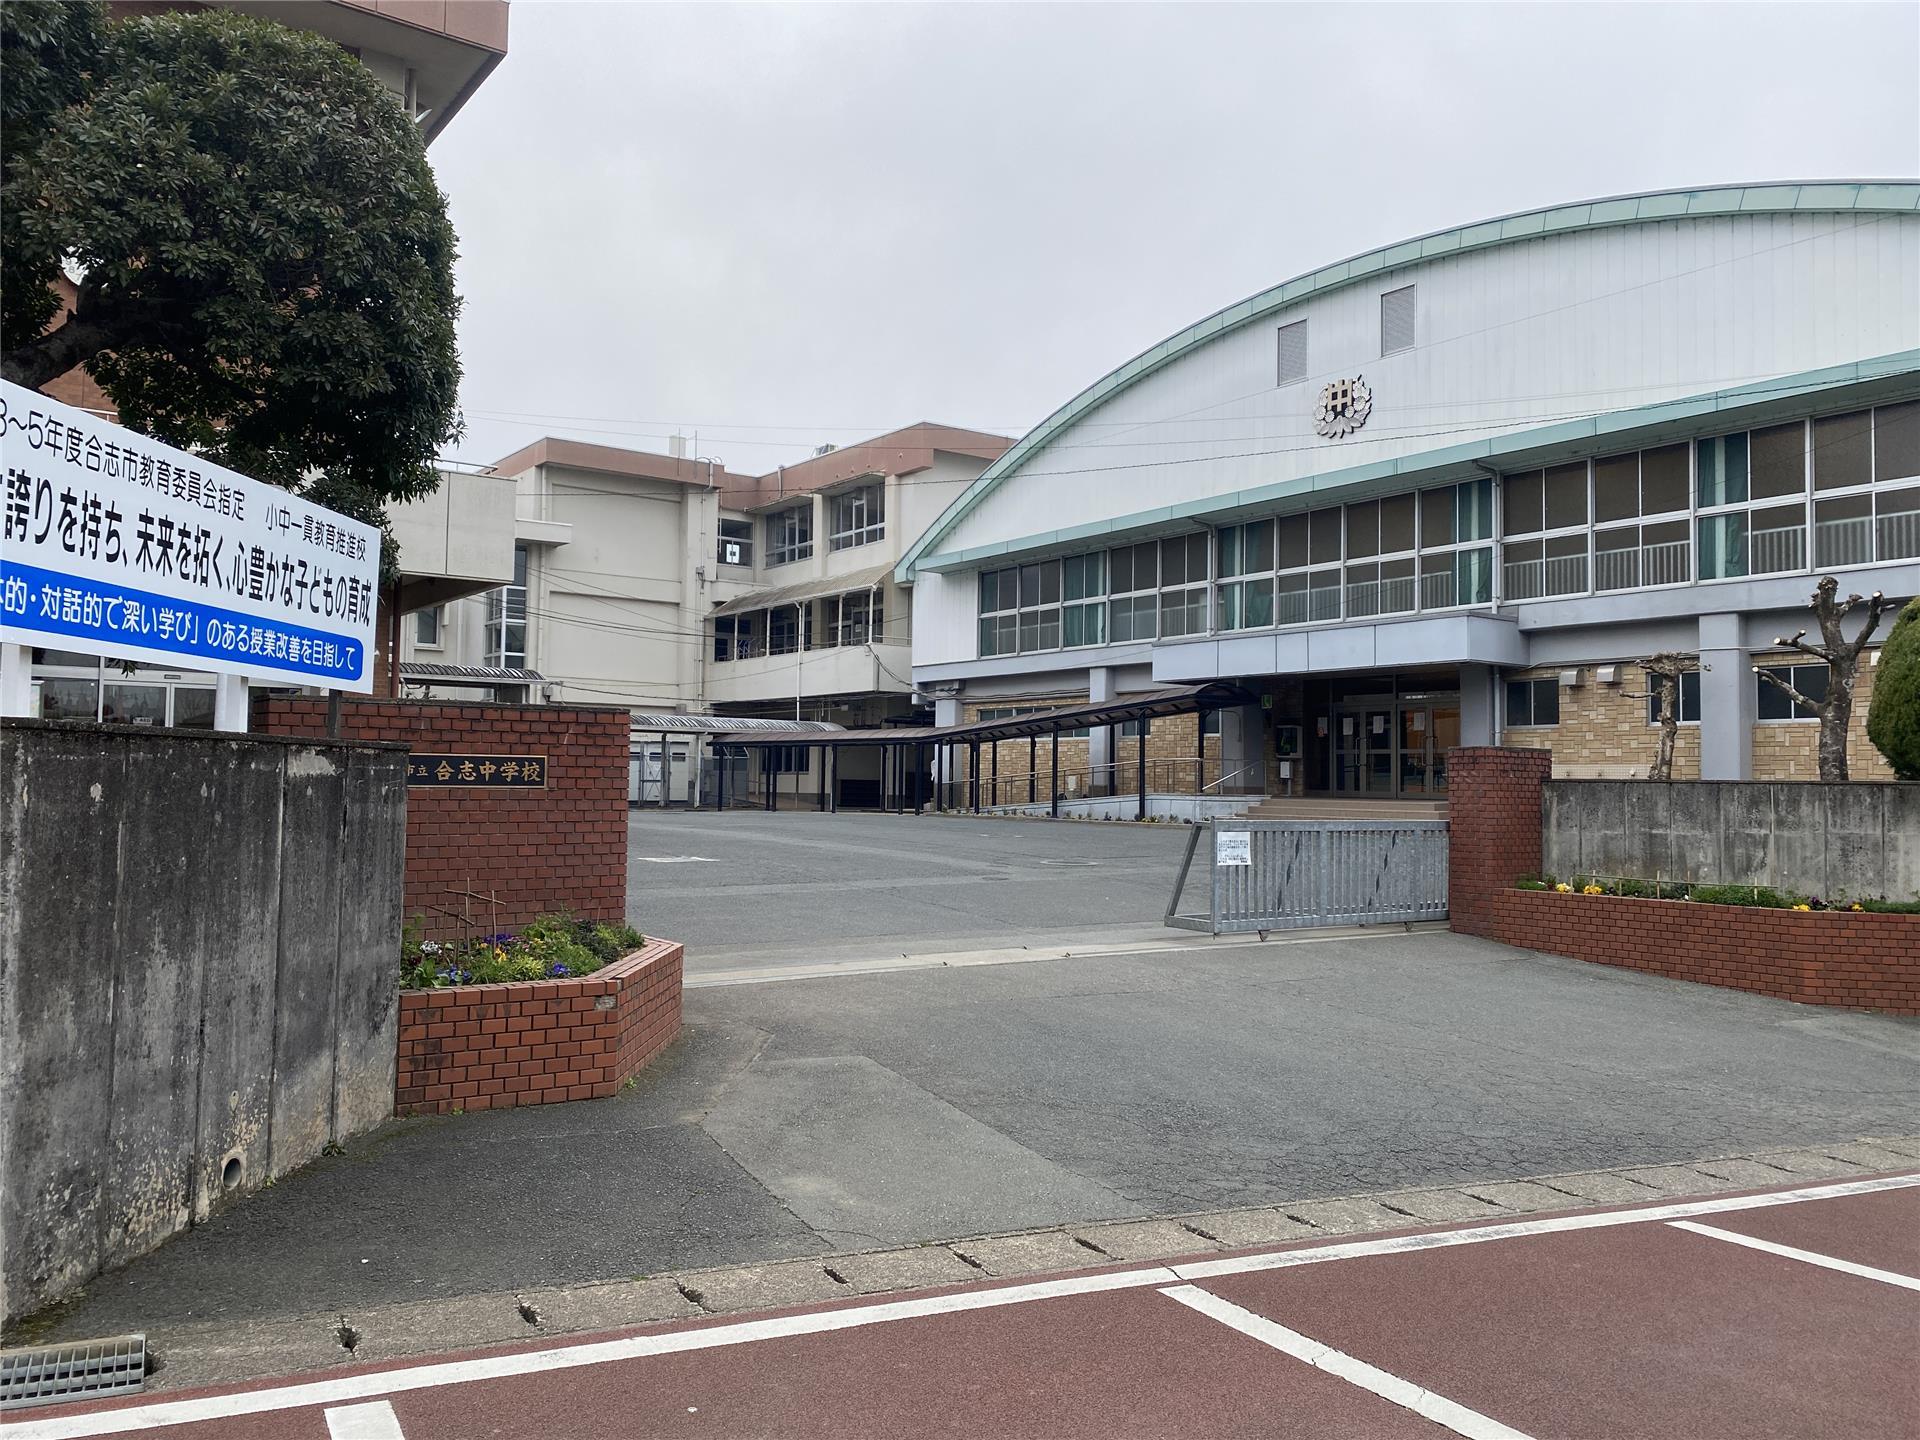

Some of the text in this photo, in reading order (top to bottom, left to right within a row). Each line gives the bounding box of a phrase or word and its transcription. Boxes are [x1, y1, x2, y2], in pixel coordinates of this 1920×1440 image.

[0, 467, 372, 627] 誇りを持ち、未来を拓く、心豊かな子どもの育成
[265, 502, 366, 562] 小中一貫教育推進校
[0, 575, 356, 670] 的・対話的で深い学び」のある授業改善を目指して
[434, 760, 542, 782] 合志中学校
